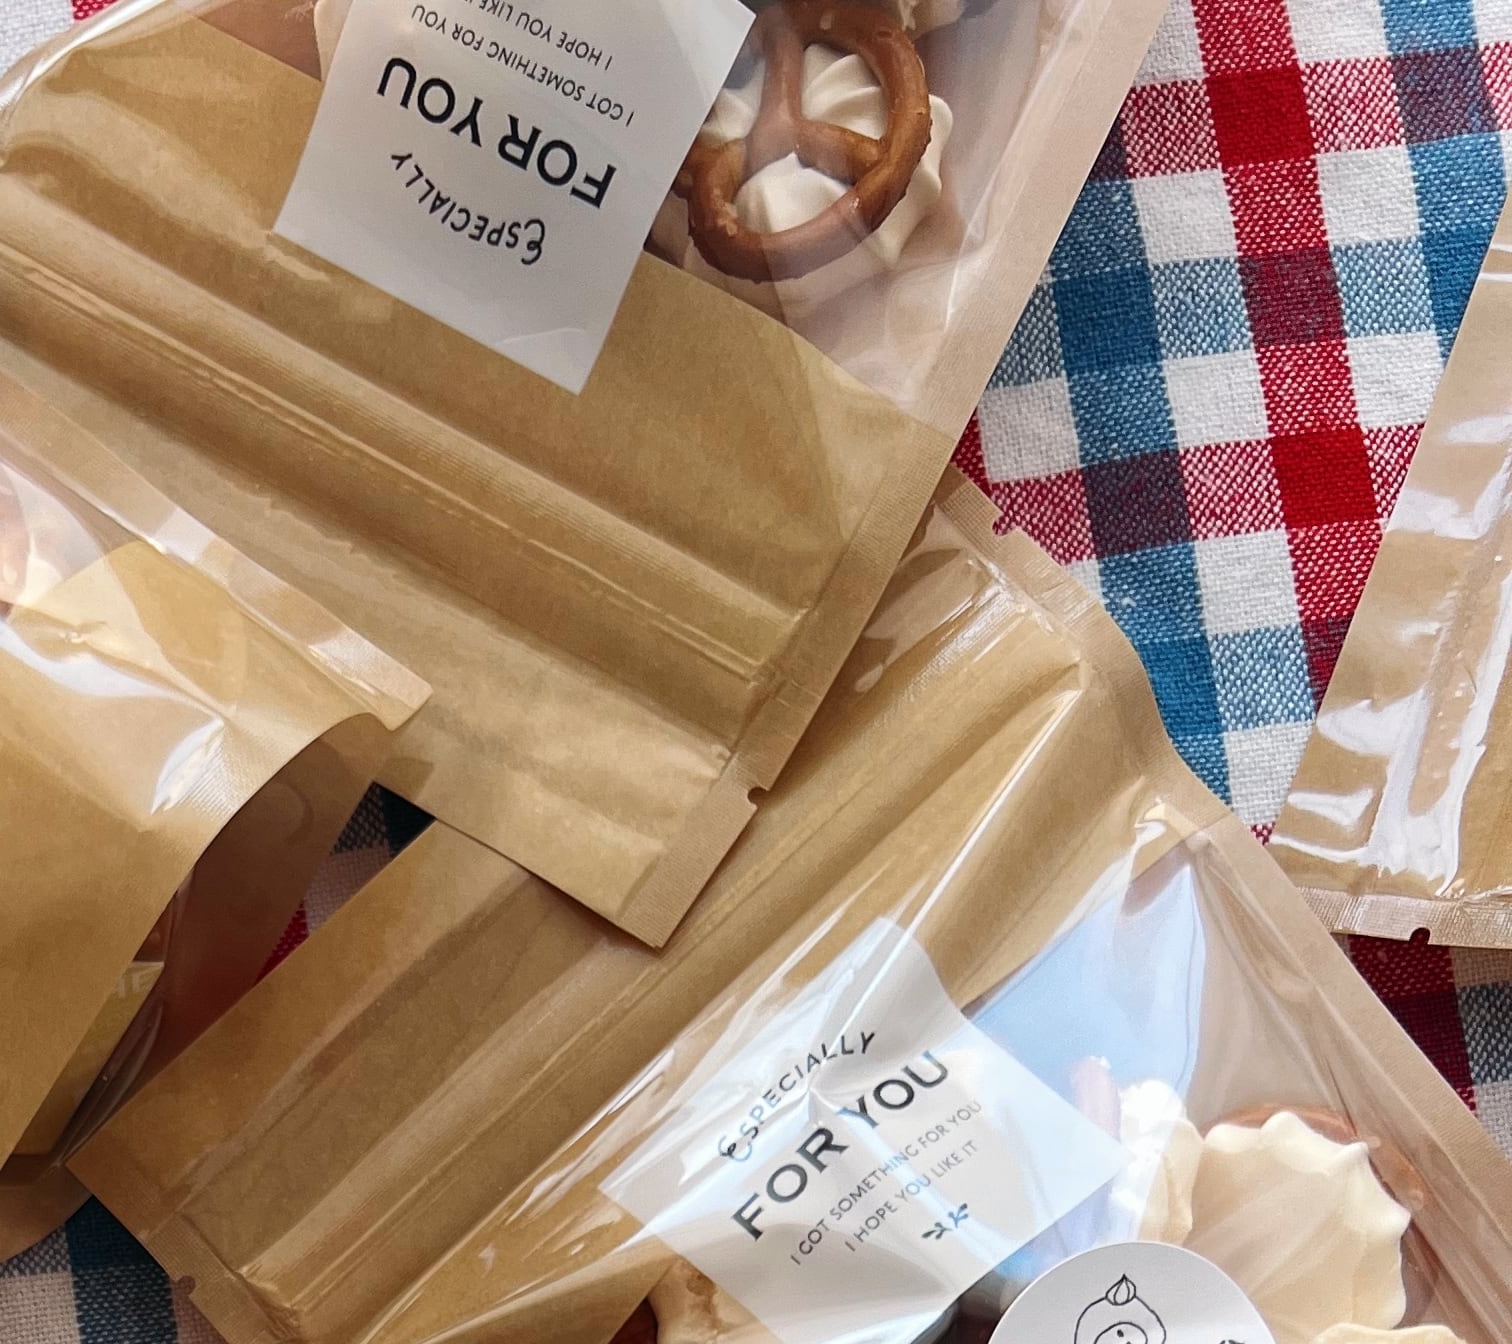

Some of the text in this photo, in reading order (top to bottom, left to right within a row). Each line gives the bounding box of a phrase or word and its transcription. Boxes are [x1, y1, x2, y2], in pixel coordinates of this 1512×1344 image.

[412, 5, 446, 34] YOU
[452, 23, 484, 51] FOR
[516, 12, 551, 39] YOU
[557, 32, 602, 65] HOPE
[486, 42, 585, 101] SOMETHING
[586, 93, 623, 120] GOT
[377, 57, 616, 208] FOR YOU
[391, 153, 545, 265] ESPECIALLY
[718, 1031, 875, 1163] ESPECIALLY
[731, 1050, 948, 1242] FOR YOU
[798, 1219, 830, 1256] GOT
[830, 1143, 919, 1220] SOMETHING
[919, 1123, 950, 1148] FOR
[950, 1101, 982, 1127] YOU
[854, 1203, 897, 1242] HOPE
[895, 1174, 932, 1203] YOU
[936, 1153, 963, 1179] LIKE
[963, 1140, 978, 1158] IT
